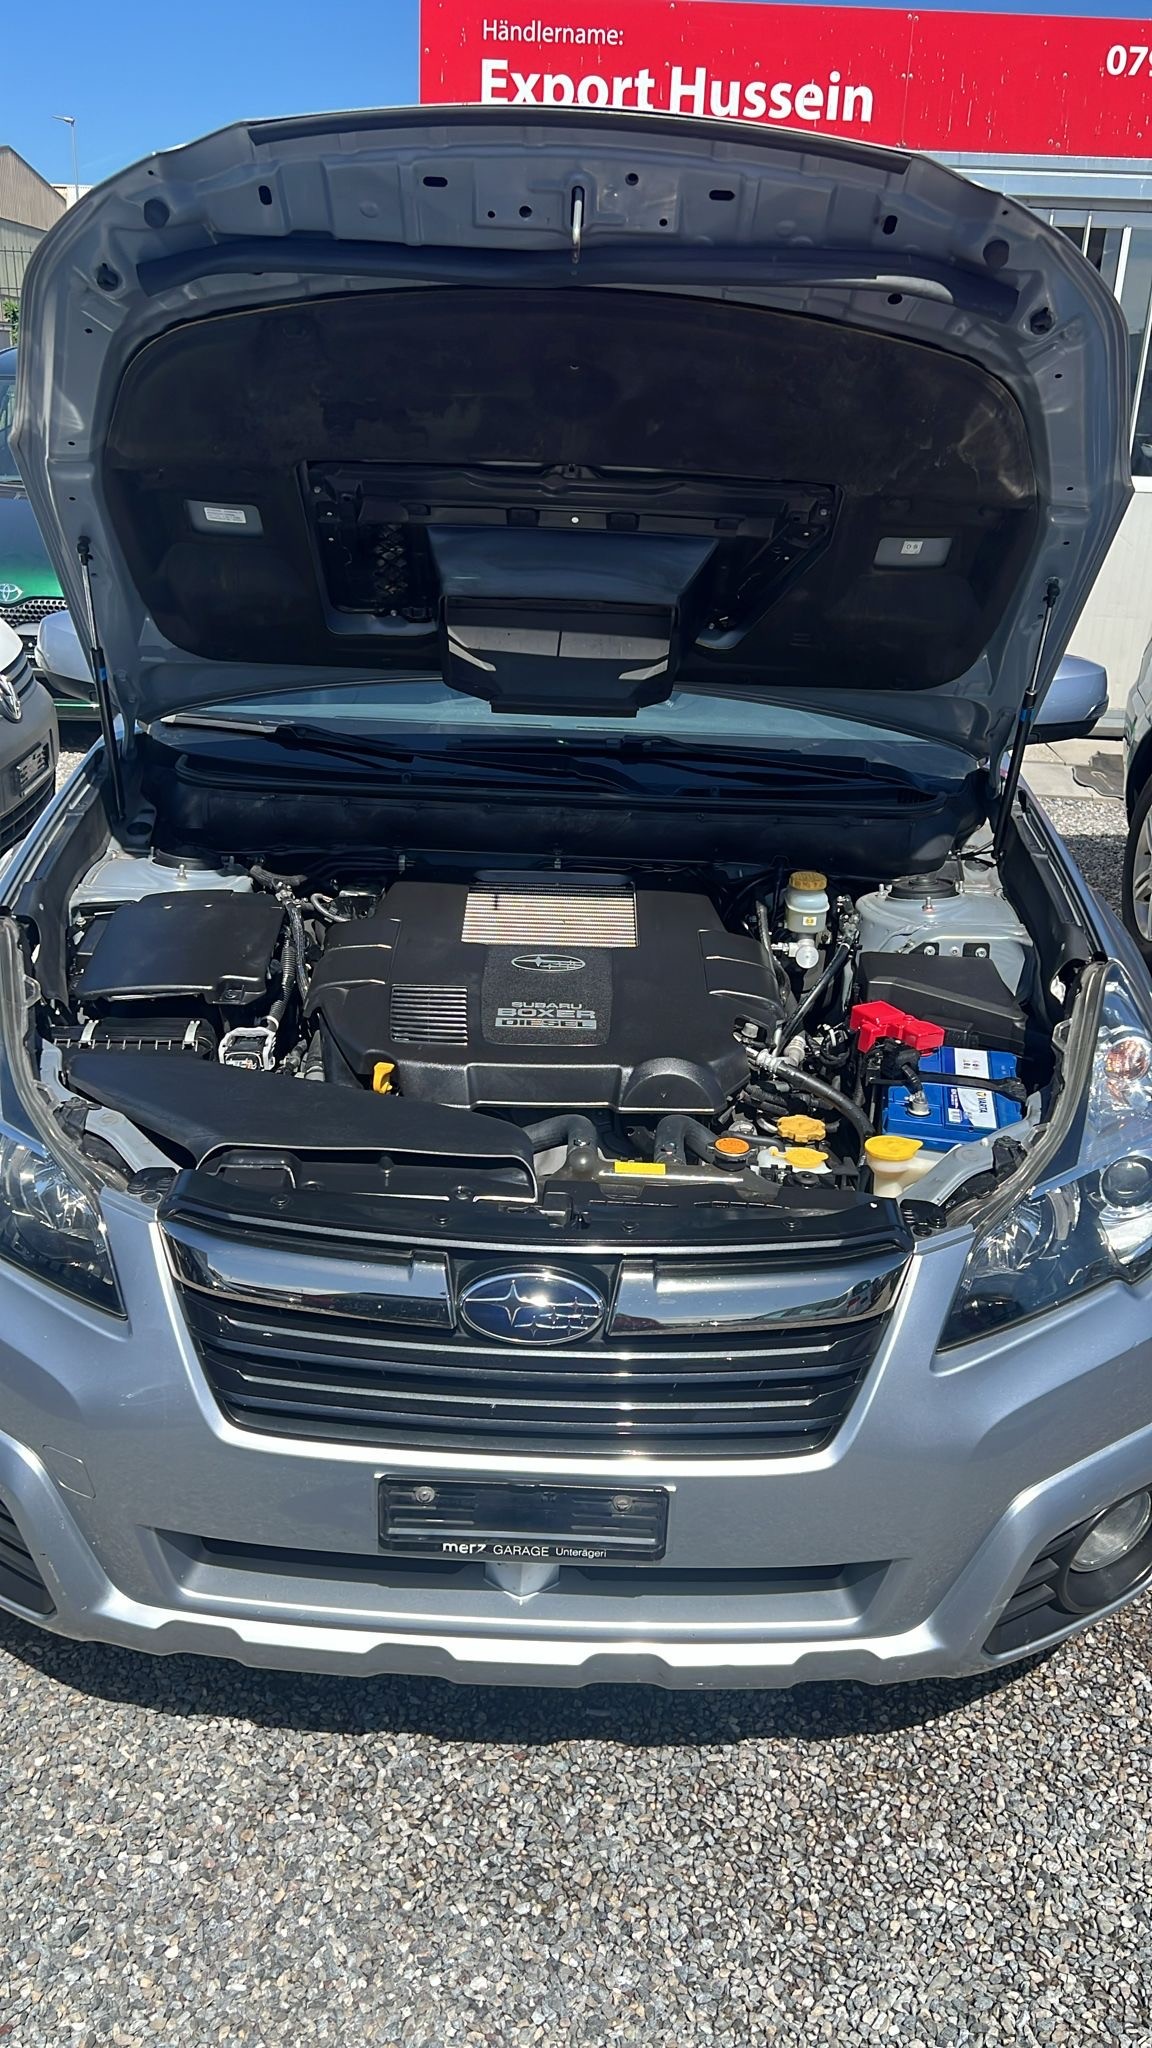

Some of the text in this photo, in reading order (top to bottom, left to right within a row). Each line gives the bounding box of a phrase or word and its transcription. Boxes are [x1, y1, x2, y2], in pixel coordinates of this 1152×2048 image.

[483, 19, 624, 46] Händlername:
[1106, 44, 1152, 77] 07
[481, 58, 874, 123] Export Hussein
[497, 1008, 596, 1018] BOXER
[498, 1018, 596, 1028] DIESEL
[977, 1097, 988, 1113] VARTA
[442, 1542, 487, 1554] merz
[493, 1545, 549, 1557] GARAGE
